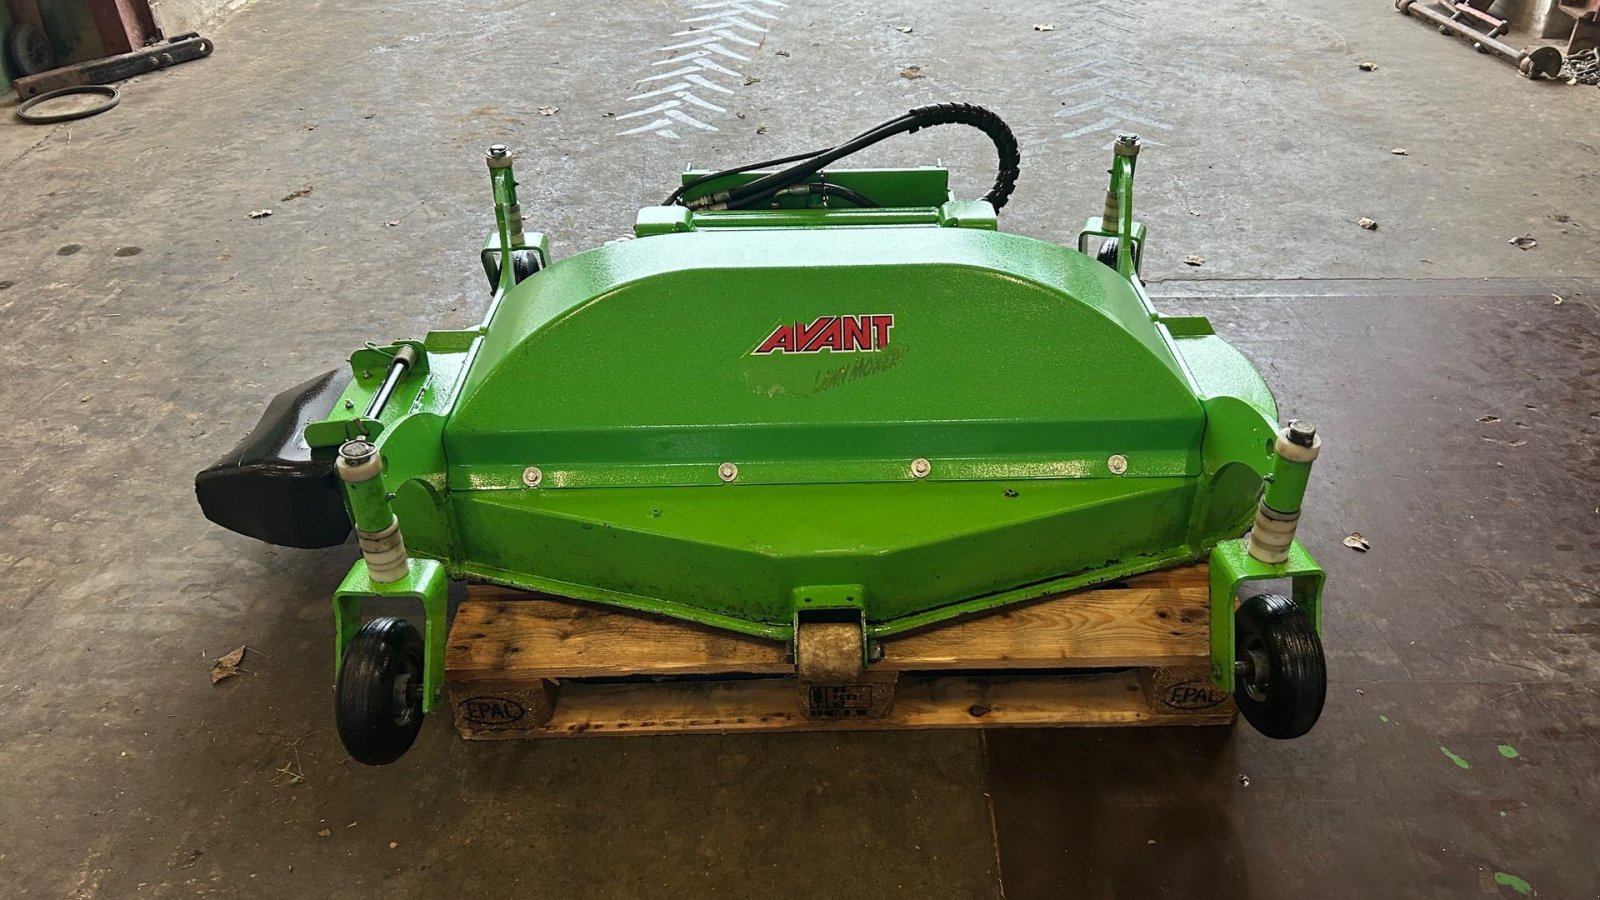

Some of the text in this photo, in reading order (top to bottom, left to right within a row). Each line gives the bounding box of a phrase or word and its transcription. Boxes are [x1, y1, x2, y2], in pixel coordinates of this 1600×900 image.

[751, 314, 894, 355] AVANT
[1171, 687, 1222, 703] EPAL
[466, 702, 519, 719] EPAL
